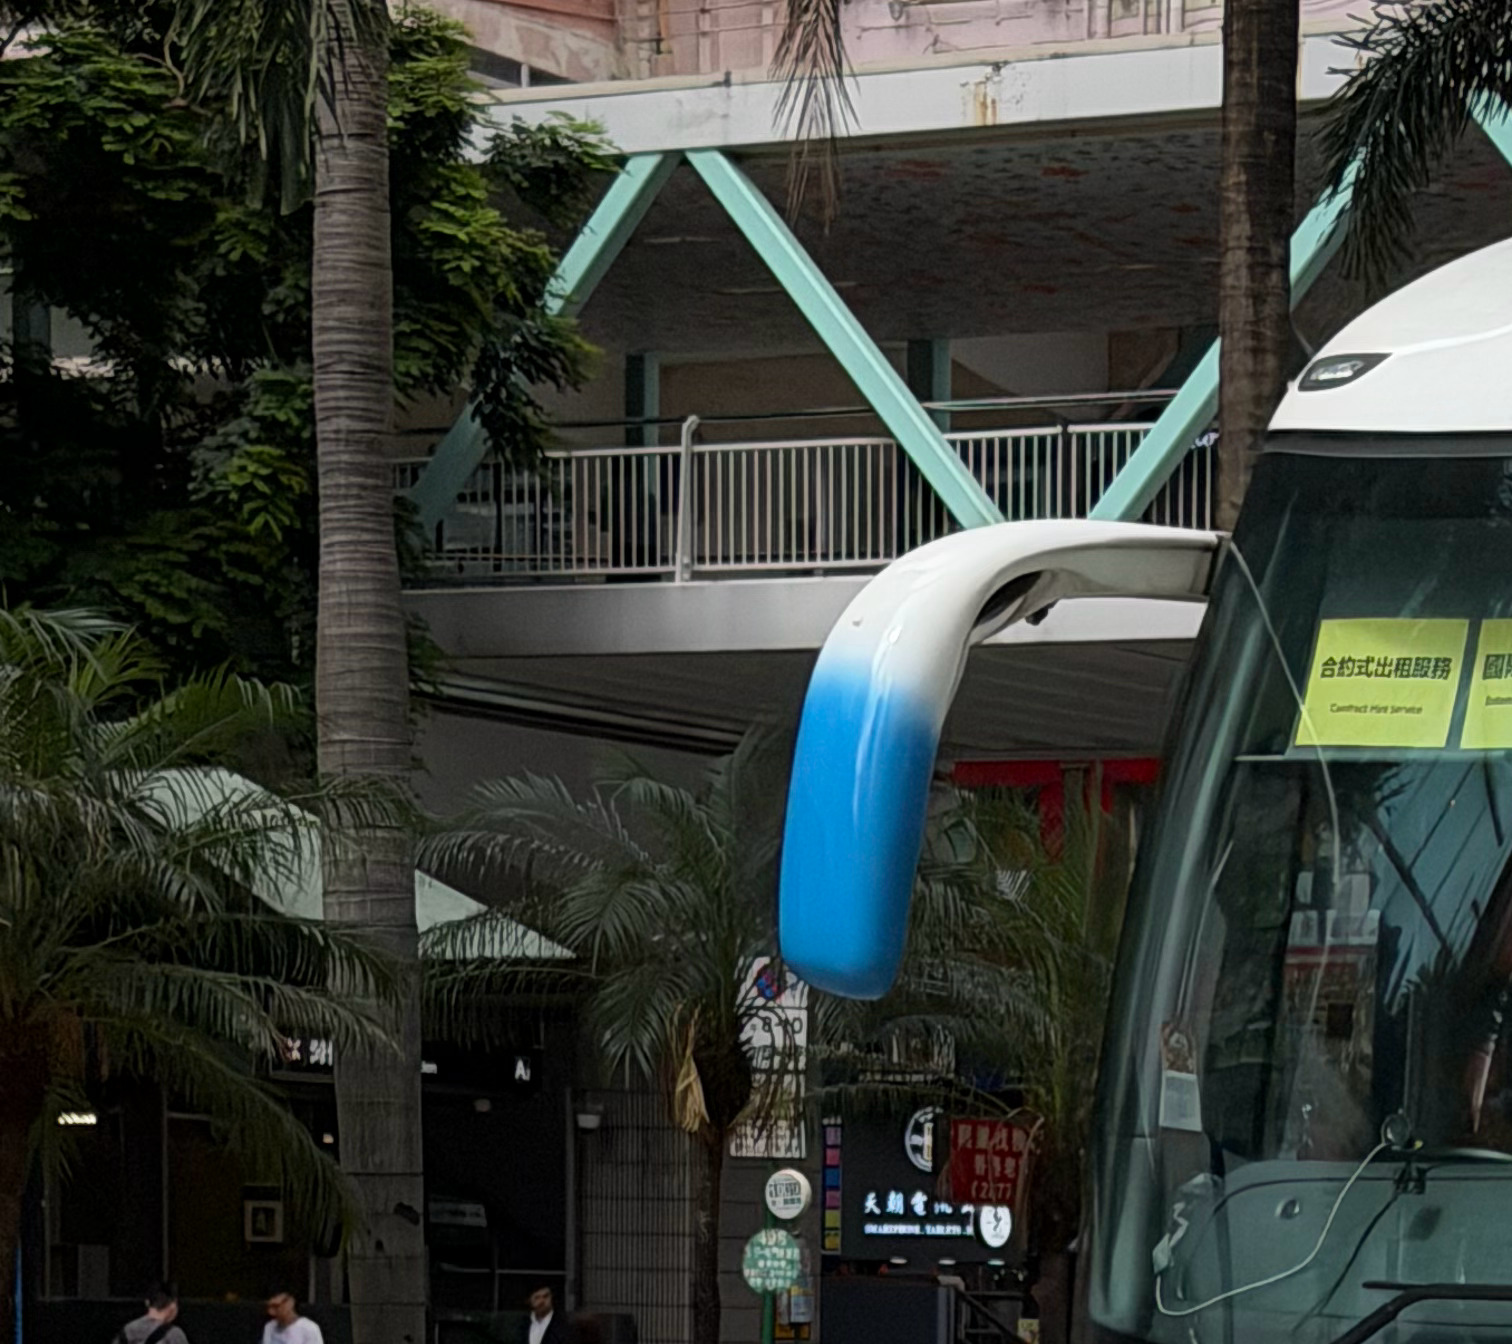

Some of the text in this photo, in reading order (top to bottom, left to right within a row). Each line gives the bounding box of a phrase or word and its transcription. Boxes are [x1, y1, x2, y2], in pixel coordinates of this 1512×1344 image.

[1319, 655, 1453, 680] 合約式出租服務
